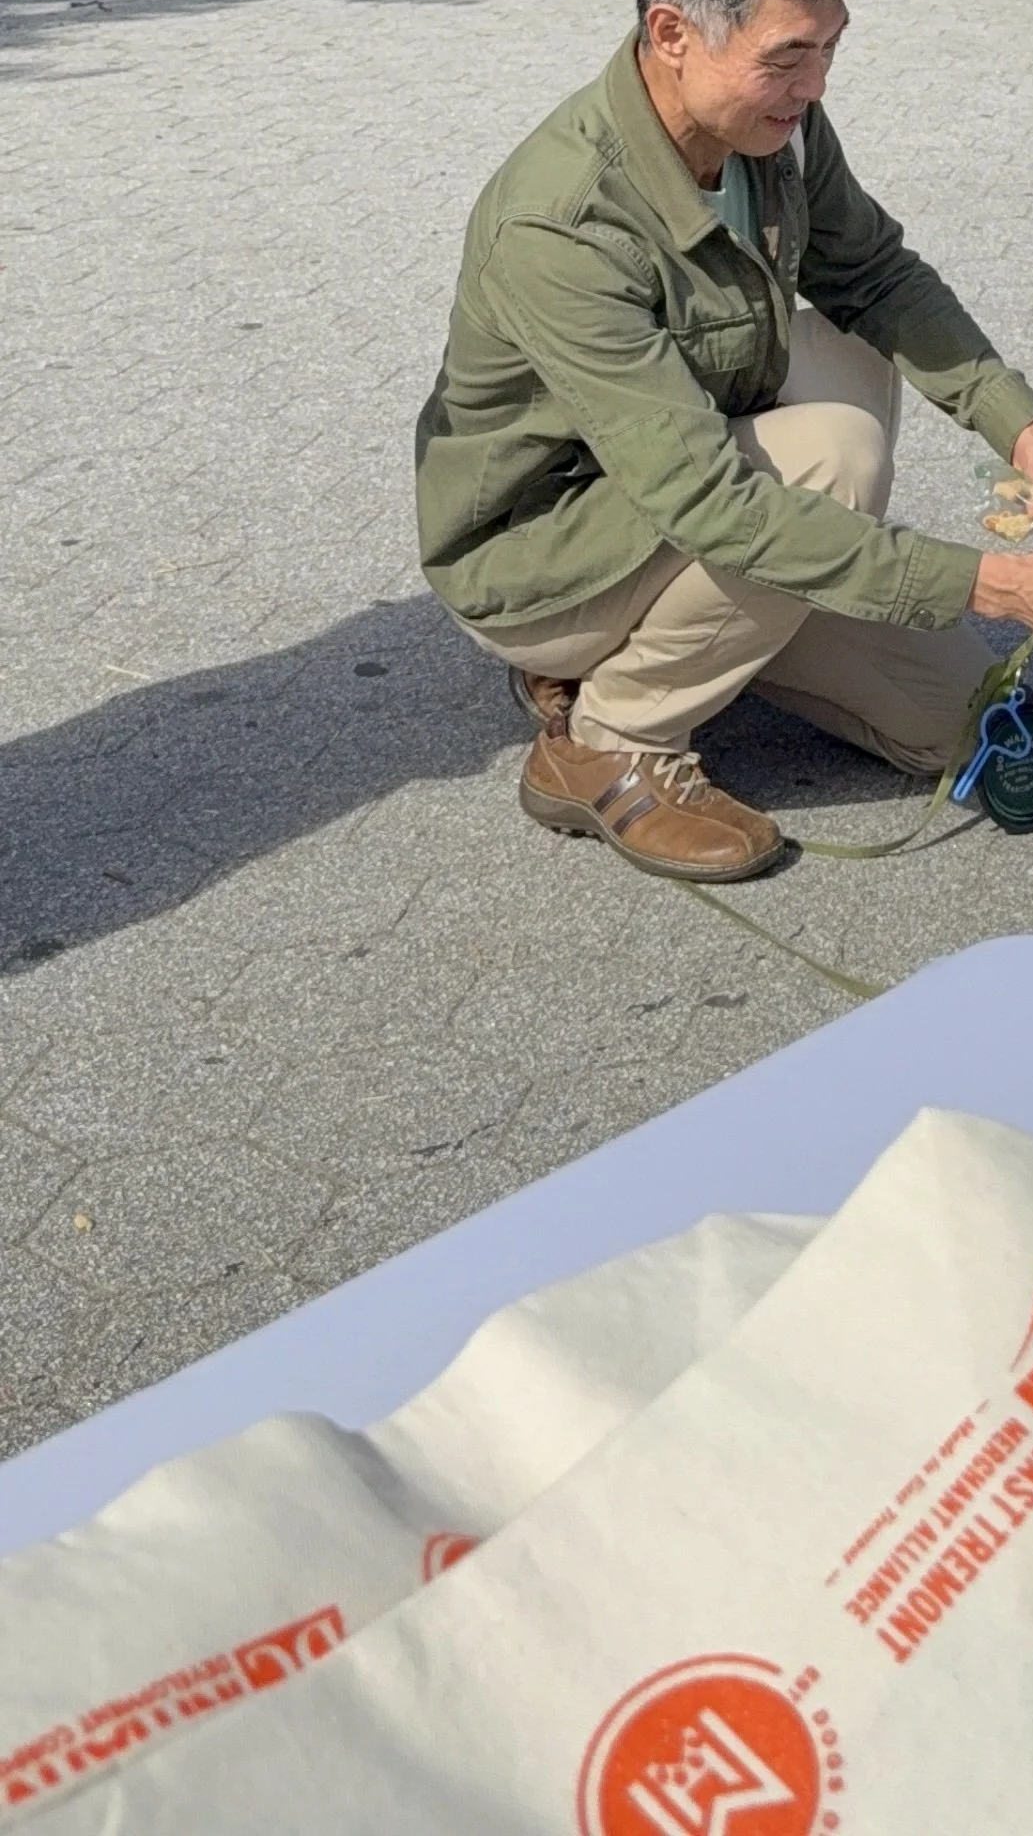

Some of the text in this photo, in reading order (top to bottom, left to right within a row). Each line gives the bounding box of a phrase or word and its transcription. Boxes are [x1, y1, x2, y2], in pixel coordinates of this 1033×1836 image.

[845, 1417, 1030, 1624] MERCHANT ALLIANCE
[876, 1513, 1009, 1663] TREMONT
